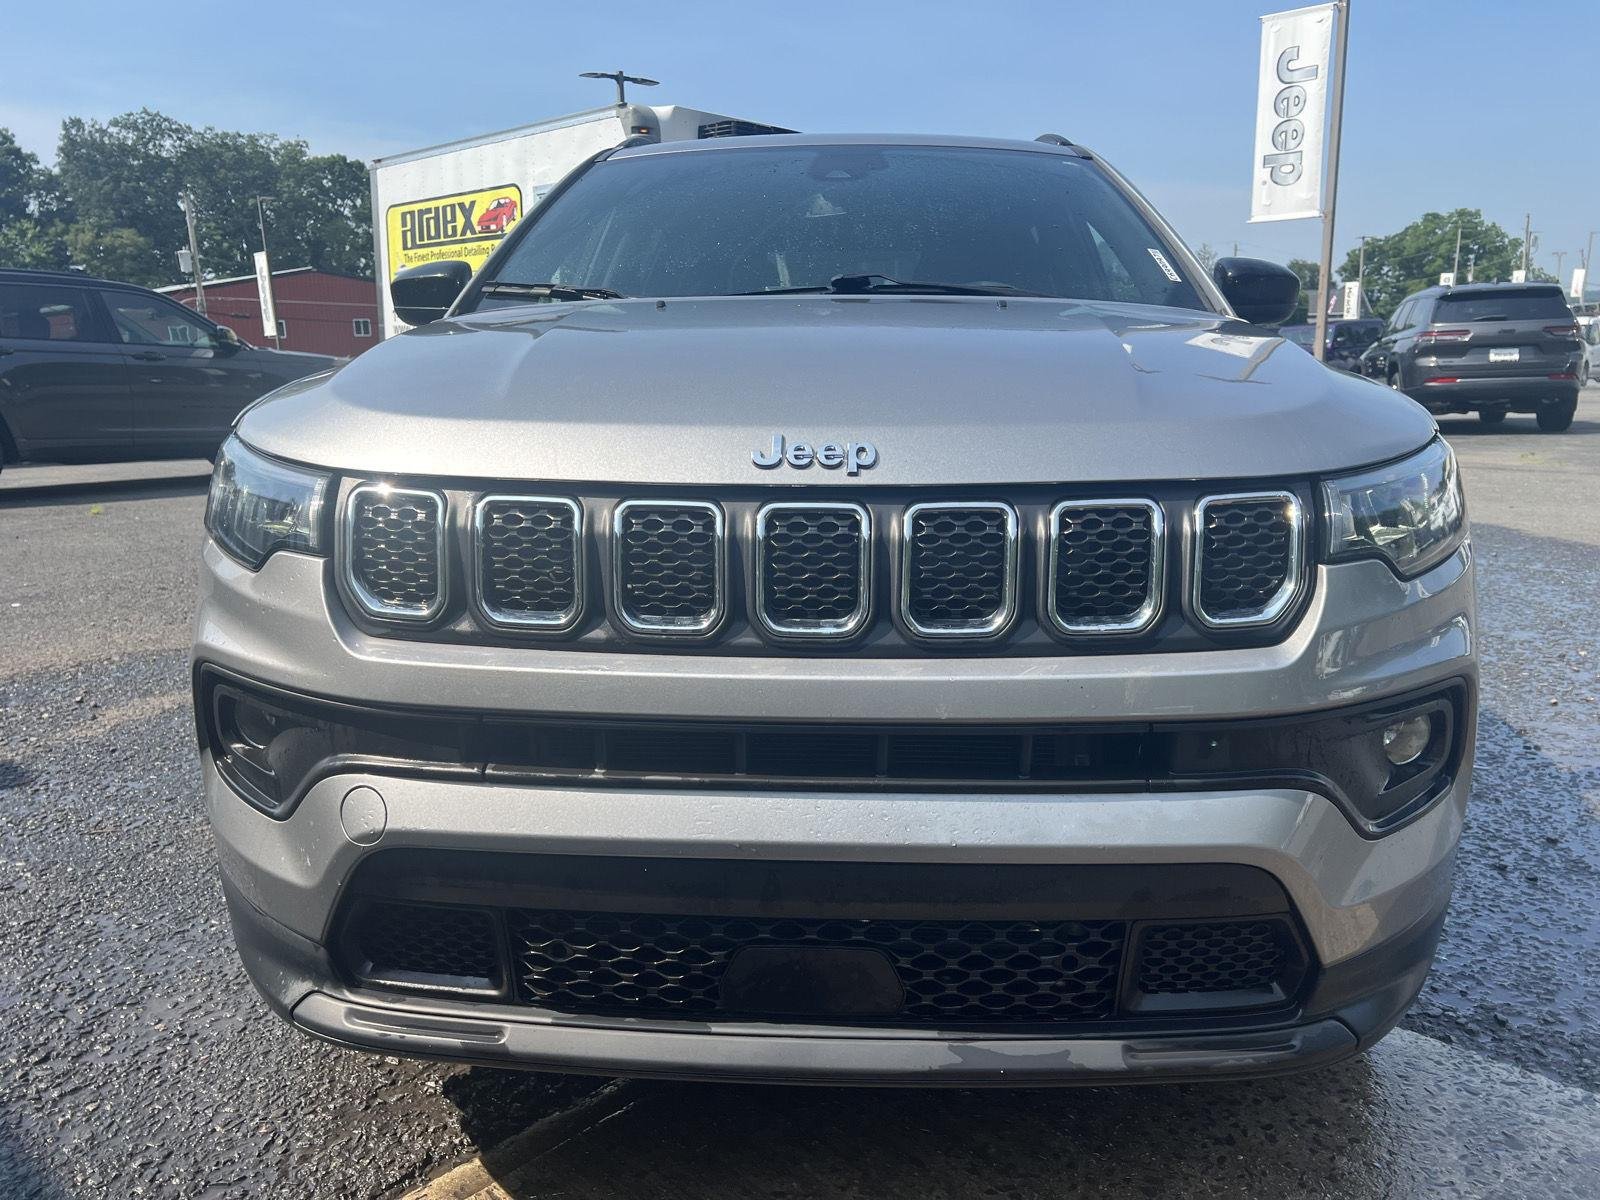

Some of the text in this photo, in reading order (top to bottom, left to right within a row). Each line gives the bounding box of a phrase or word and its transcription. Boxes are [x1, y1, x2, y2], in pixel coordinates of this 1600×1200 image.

[1263, 45, 1319, 186] Jeep
[401, 200, 477, 250] ardex
[404, 254, 413, 265] The
[414, 251, 429, 262] Finest
[430, 247, 462, 260] Professional
[751, 434, 877, 476] Jeep
